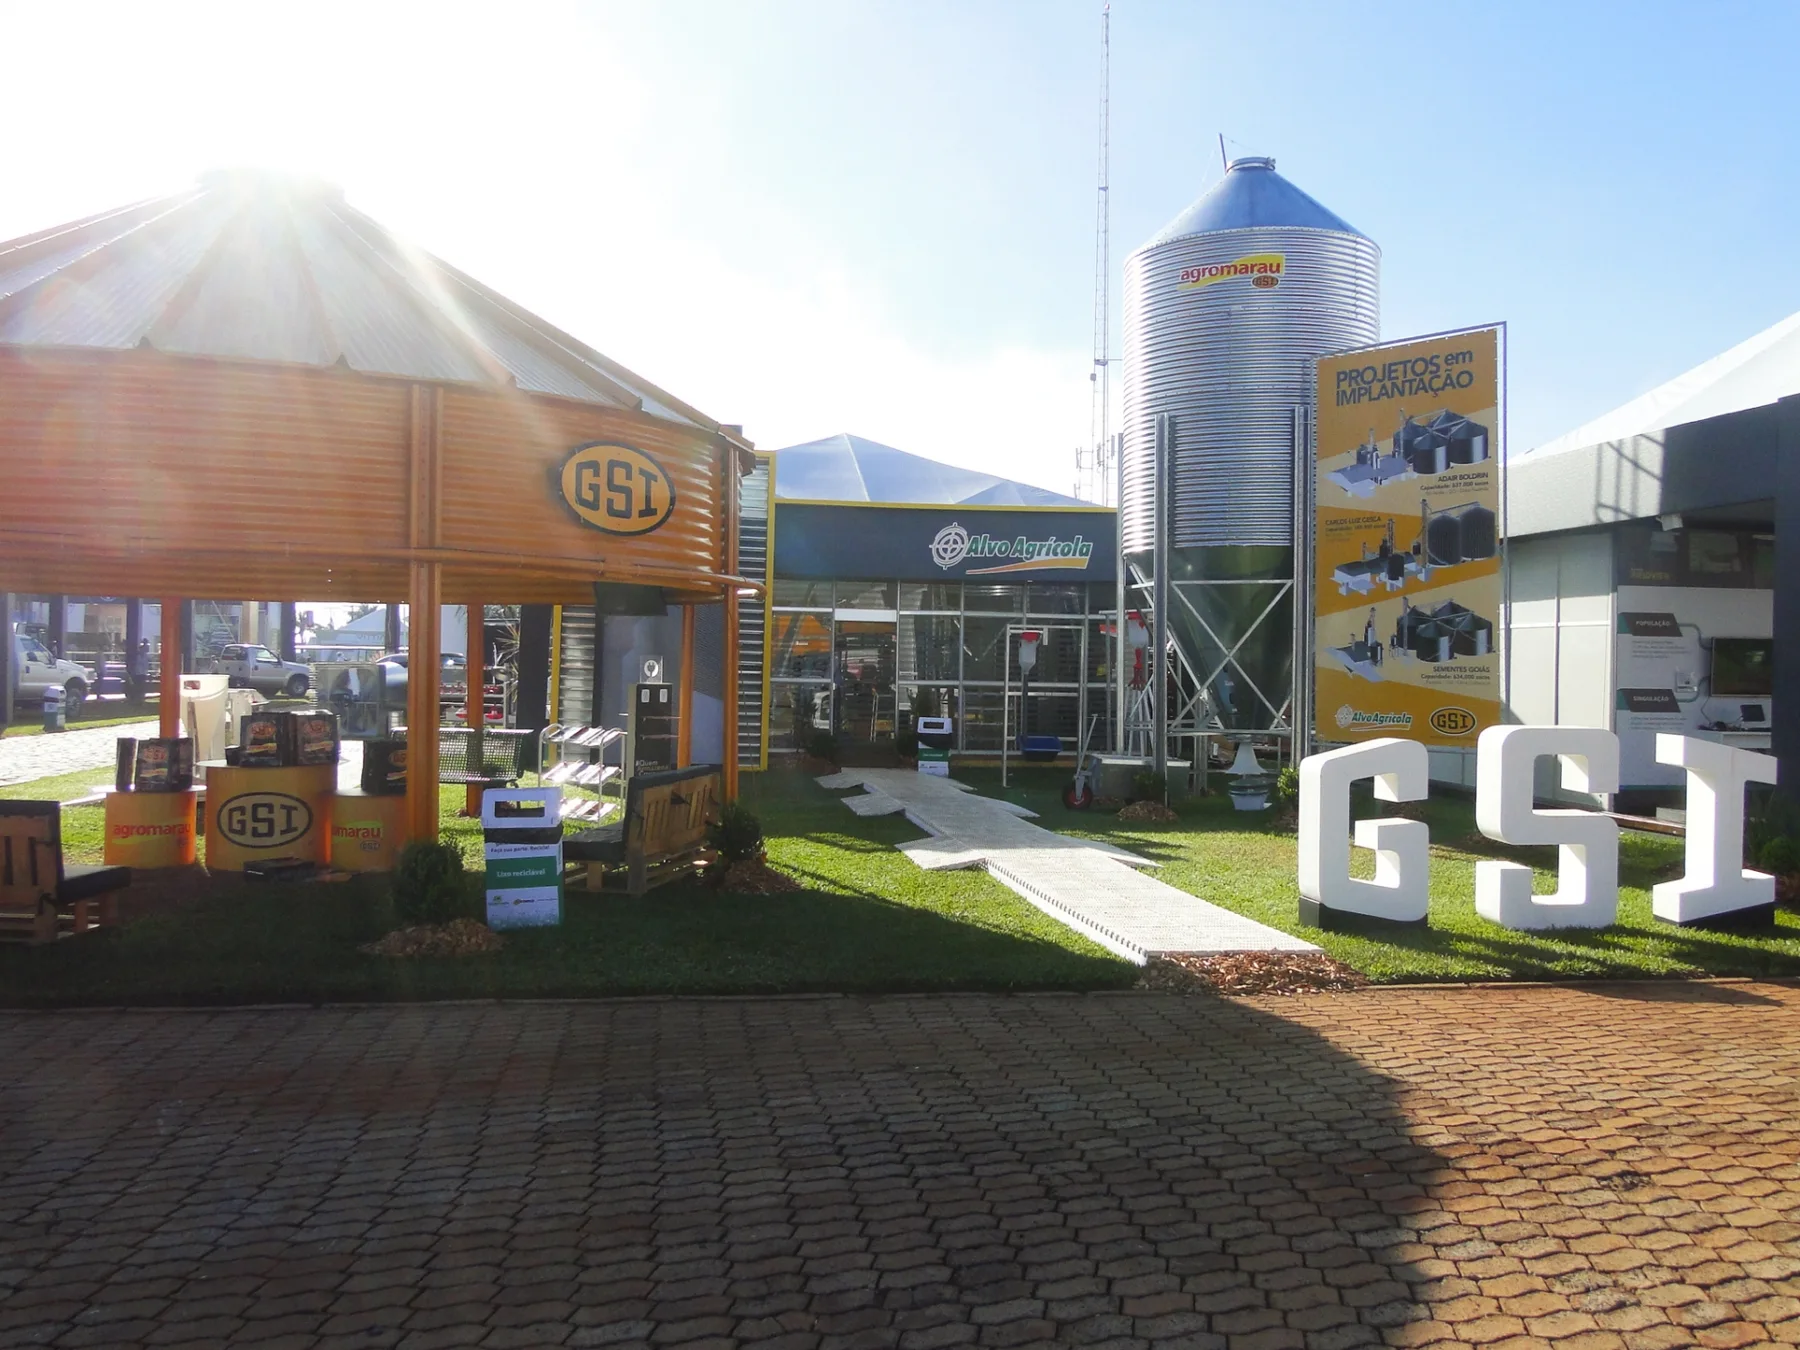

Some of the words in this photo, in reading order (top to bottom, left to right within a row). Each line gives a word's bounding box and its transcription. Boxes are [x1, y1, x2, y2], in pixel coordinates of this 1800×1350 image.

[1180, 262, 1281, 283] agromarau
[1336, 354, 1441, 389] PROJETOS
[1444, 350, 1473, 366] em
[1336, 368, 1474, 406] IMPLANTAÇÃO
[1459, 472, 1489, 481] BOLDRIN
[575, 459, 658, 519] GSI
[965, 534, 1010, 557] Alvo
[1010, 535, 1093, 562] Agrícola
[1433, 665, 1468, 673] SEMENTES
[1468, 664, 1490, 673] GOIÁS
[1633, 695, 1670, 703] SINGULAÇÃO
[1436, 712, 1469, 730] GSI
[114, 823, 191, 838] agromarau
[228, 803, 299, 838] GSI
[1299, 725, 1777, 931] GSI
[496, 870, 512, 878] Lixo
[512, 868, 546, 876] reciclável
